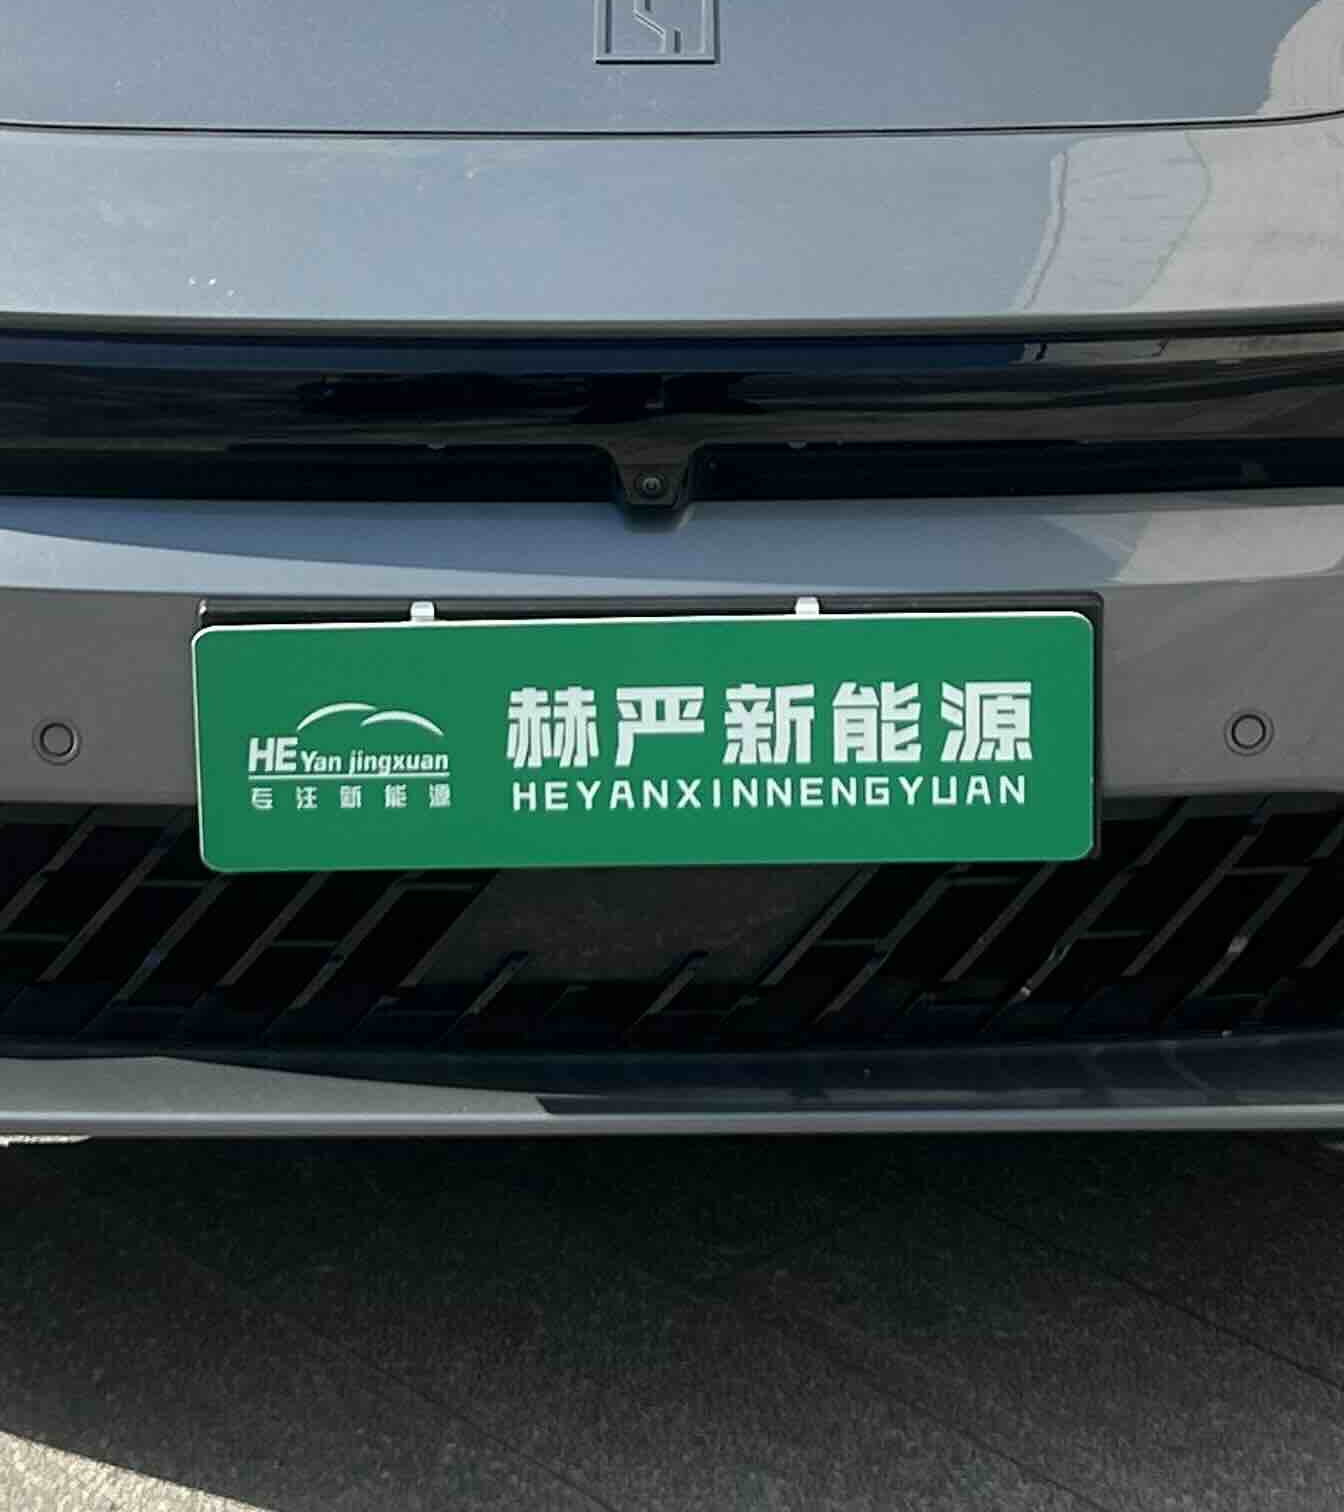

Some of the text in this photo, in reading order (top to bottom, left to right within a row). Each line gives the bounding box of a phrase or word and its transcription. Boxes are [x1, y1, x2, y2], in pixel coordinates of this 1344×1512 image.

[506, 681, 1033, 769] 赫严新能源
[512, 775, 1025, 811] HEYANXINNENGYUAN
